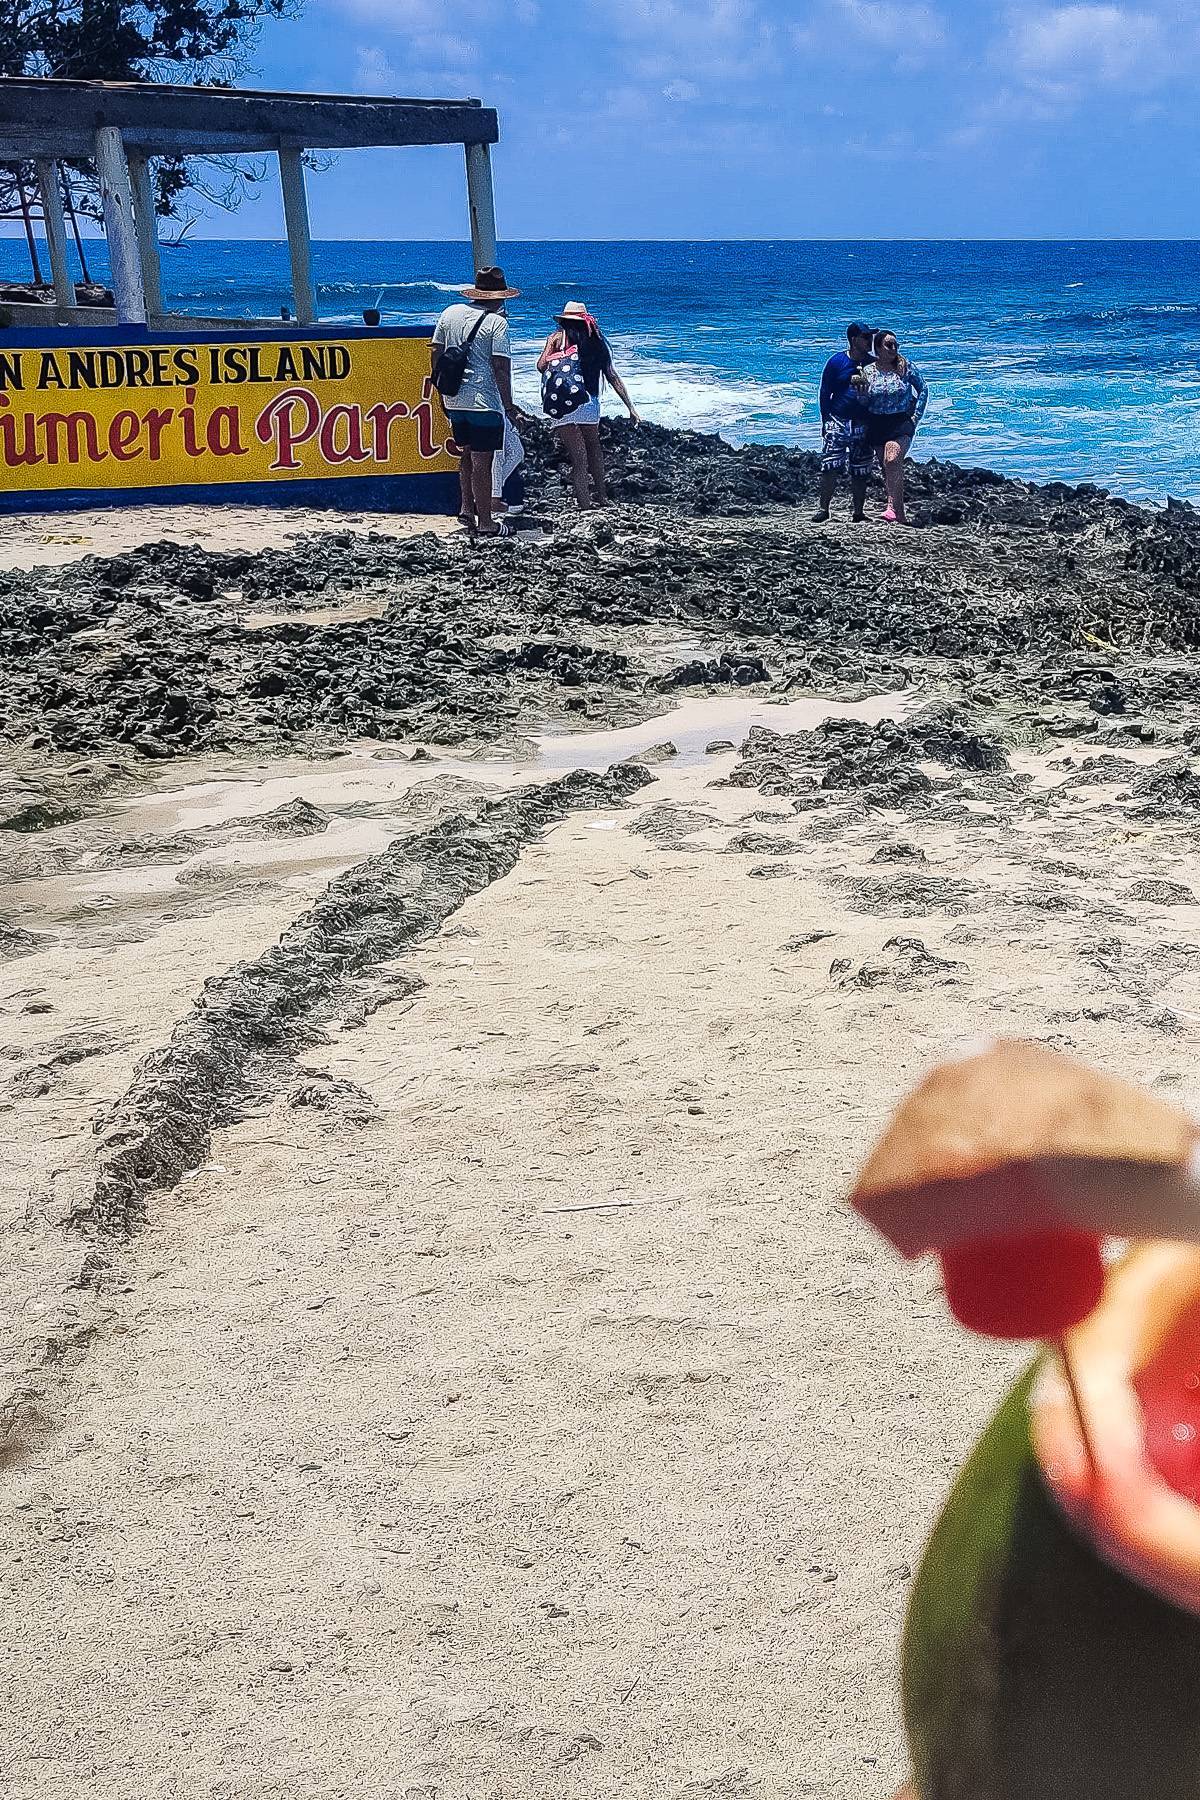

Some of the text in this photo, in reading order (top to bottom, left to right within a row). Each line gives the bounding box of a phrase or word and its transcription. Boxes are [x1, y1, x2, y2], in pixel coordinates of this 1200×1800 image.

[36, 349, 200, 390] ANDRES
[208, 346, 351, 384] ISLAND
[0, 387, 250, 467] umeria
